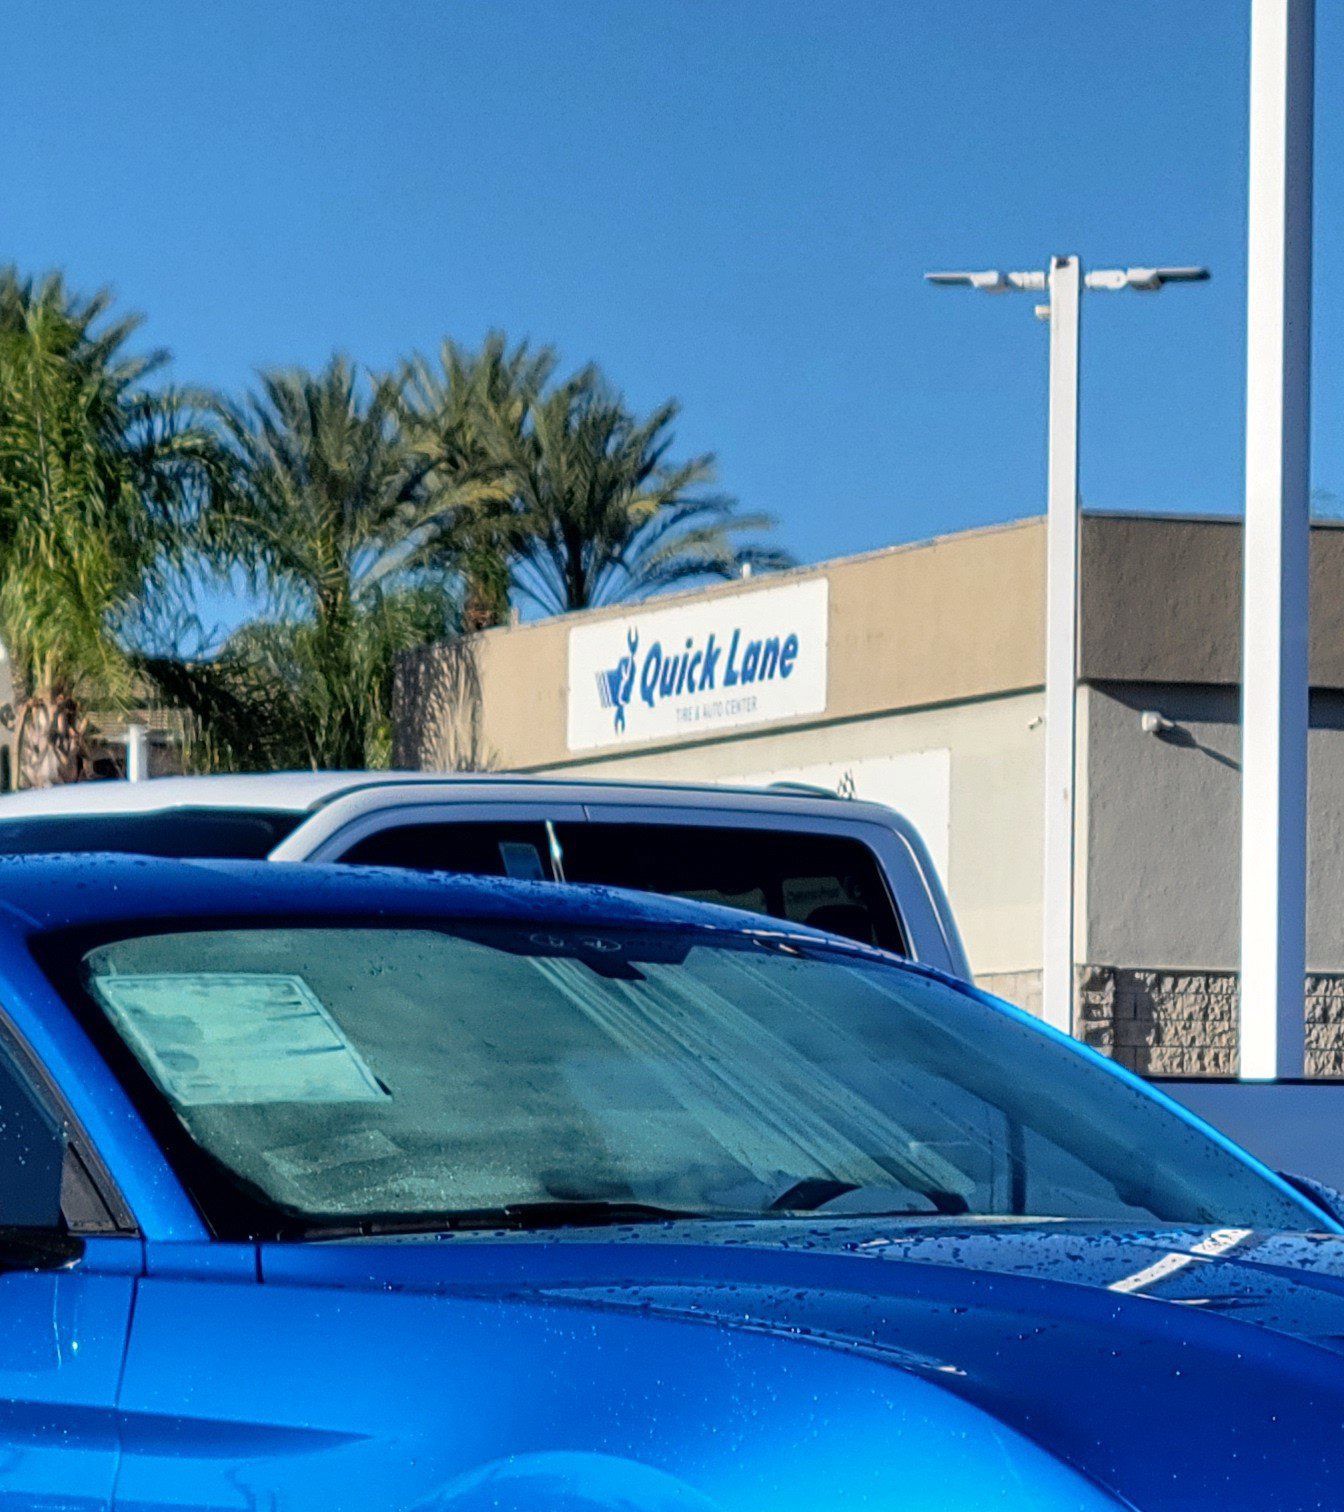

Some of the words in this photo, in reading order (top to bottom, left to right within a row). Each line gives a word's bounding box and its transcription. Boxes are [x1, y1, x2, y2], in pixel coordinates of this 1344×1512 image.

[640, 632, 722, 708] Quick
[723, 628, 799, 688] Lane
[725, 695, 758, 716] CENTER
